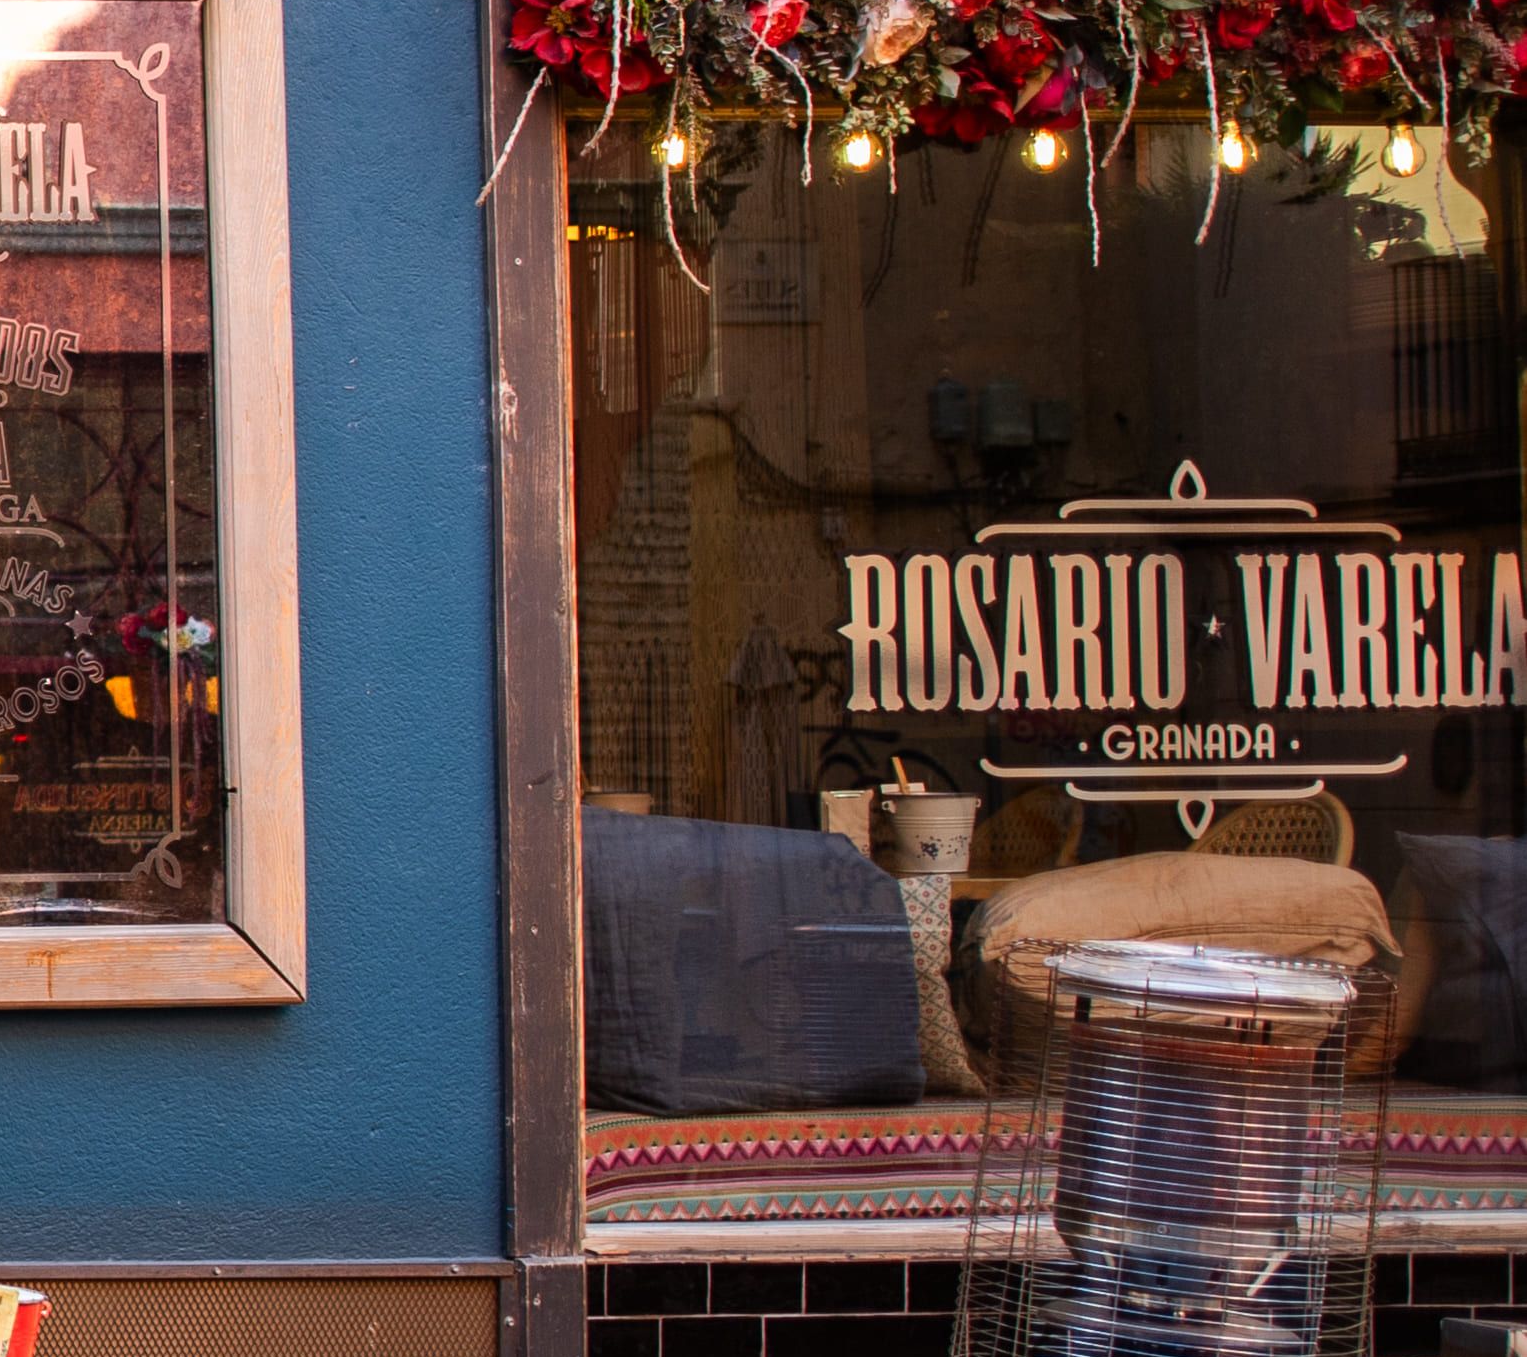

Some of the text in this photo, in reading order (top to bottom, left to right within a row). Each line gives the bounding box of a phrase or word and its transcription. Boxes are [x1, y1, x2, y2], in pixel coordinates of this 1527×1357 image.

[837, 552, 1527, 711] ROSARIO VARELA
[1102, 724, 1276, 760] GRANADA
